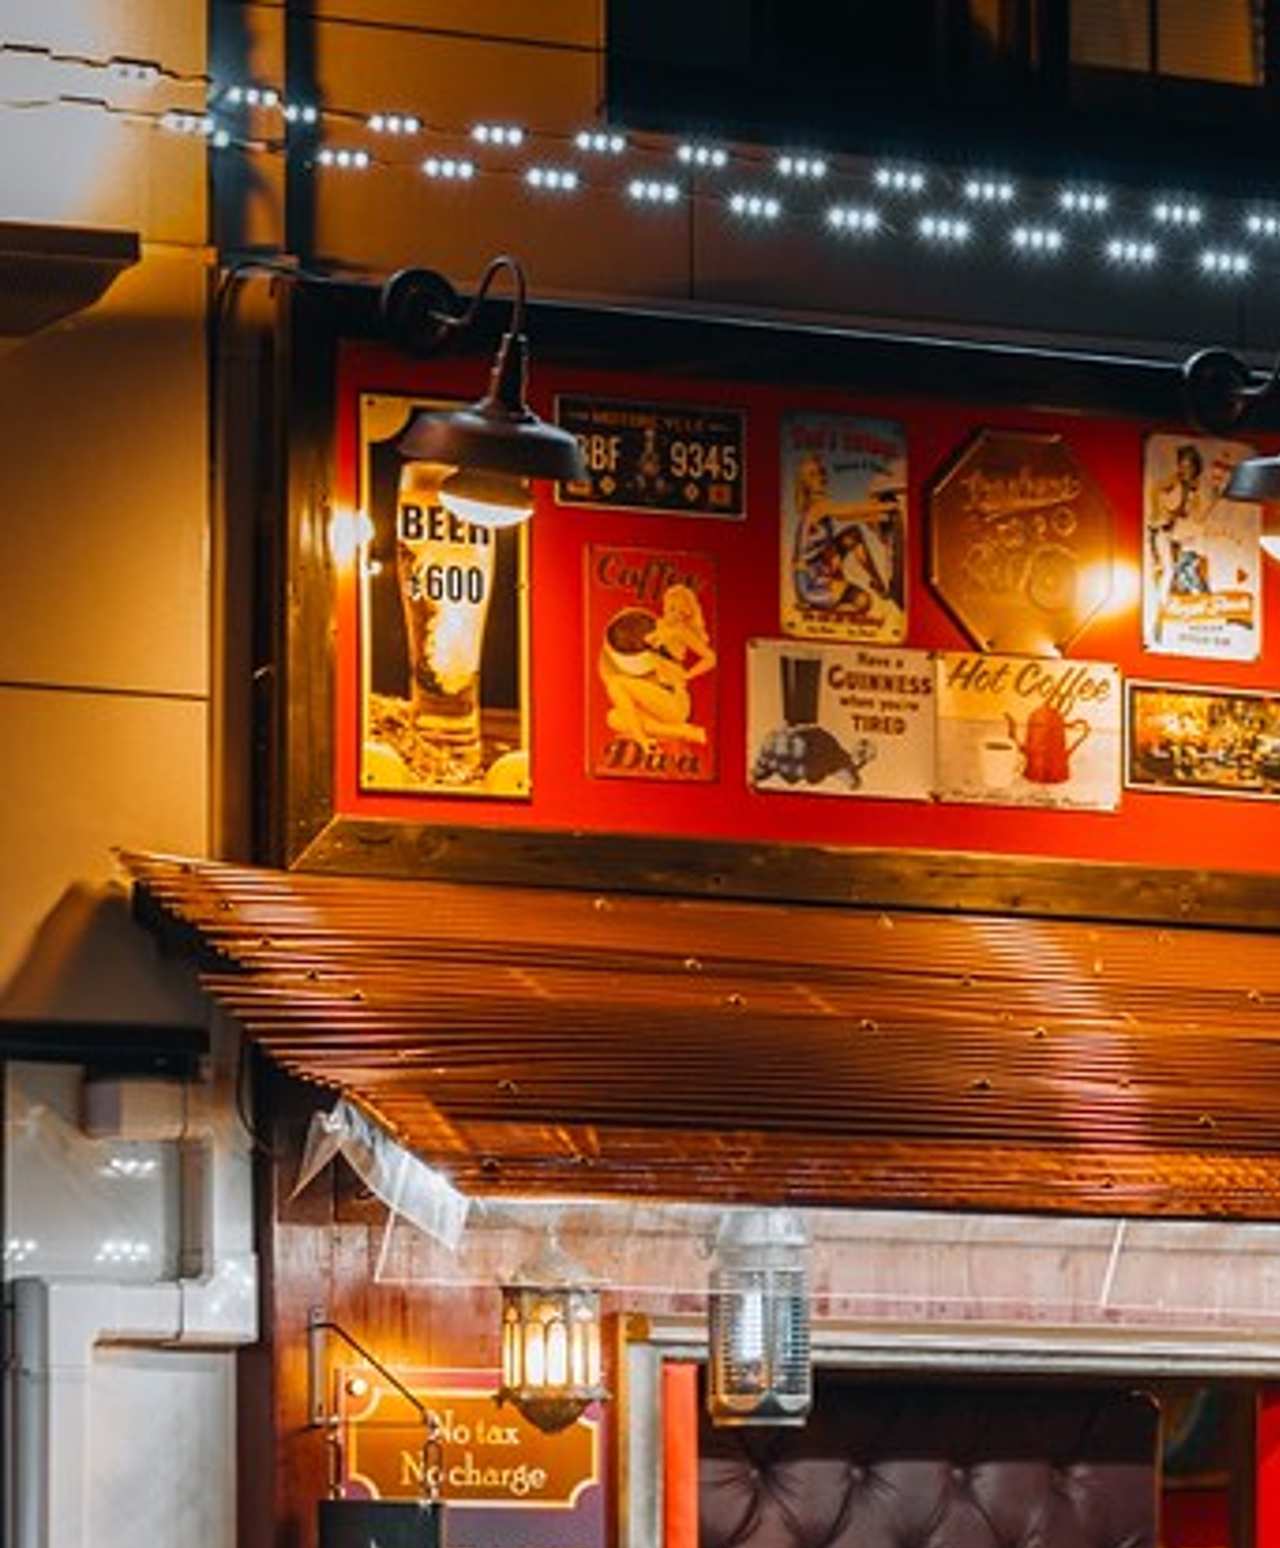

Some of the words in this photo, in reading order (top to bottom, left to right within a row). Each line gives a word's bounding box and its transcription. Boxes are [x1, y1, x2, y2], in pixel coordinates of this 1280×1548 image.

[670, 441, 739, 481] 9345
[828, 665, 932, 695] GUINNESS
[947, 659, 1008, 692] Hot
[1013, 662, 1111, 715] Coffee
[853, 714, 905, 734] TIRED
[604, 740, 701, 773] Diva
[428, 1409, 470, 1444] No
[475, 1424, 519, 1445] tax
[401, 1451, 443, 1486] No
[449, 1453, 546, 1495] charge
